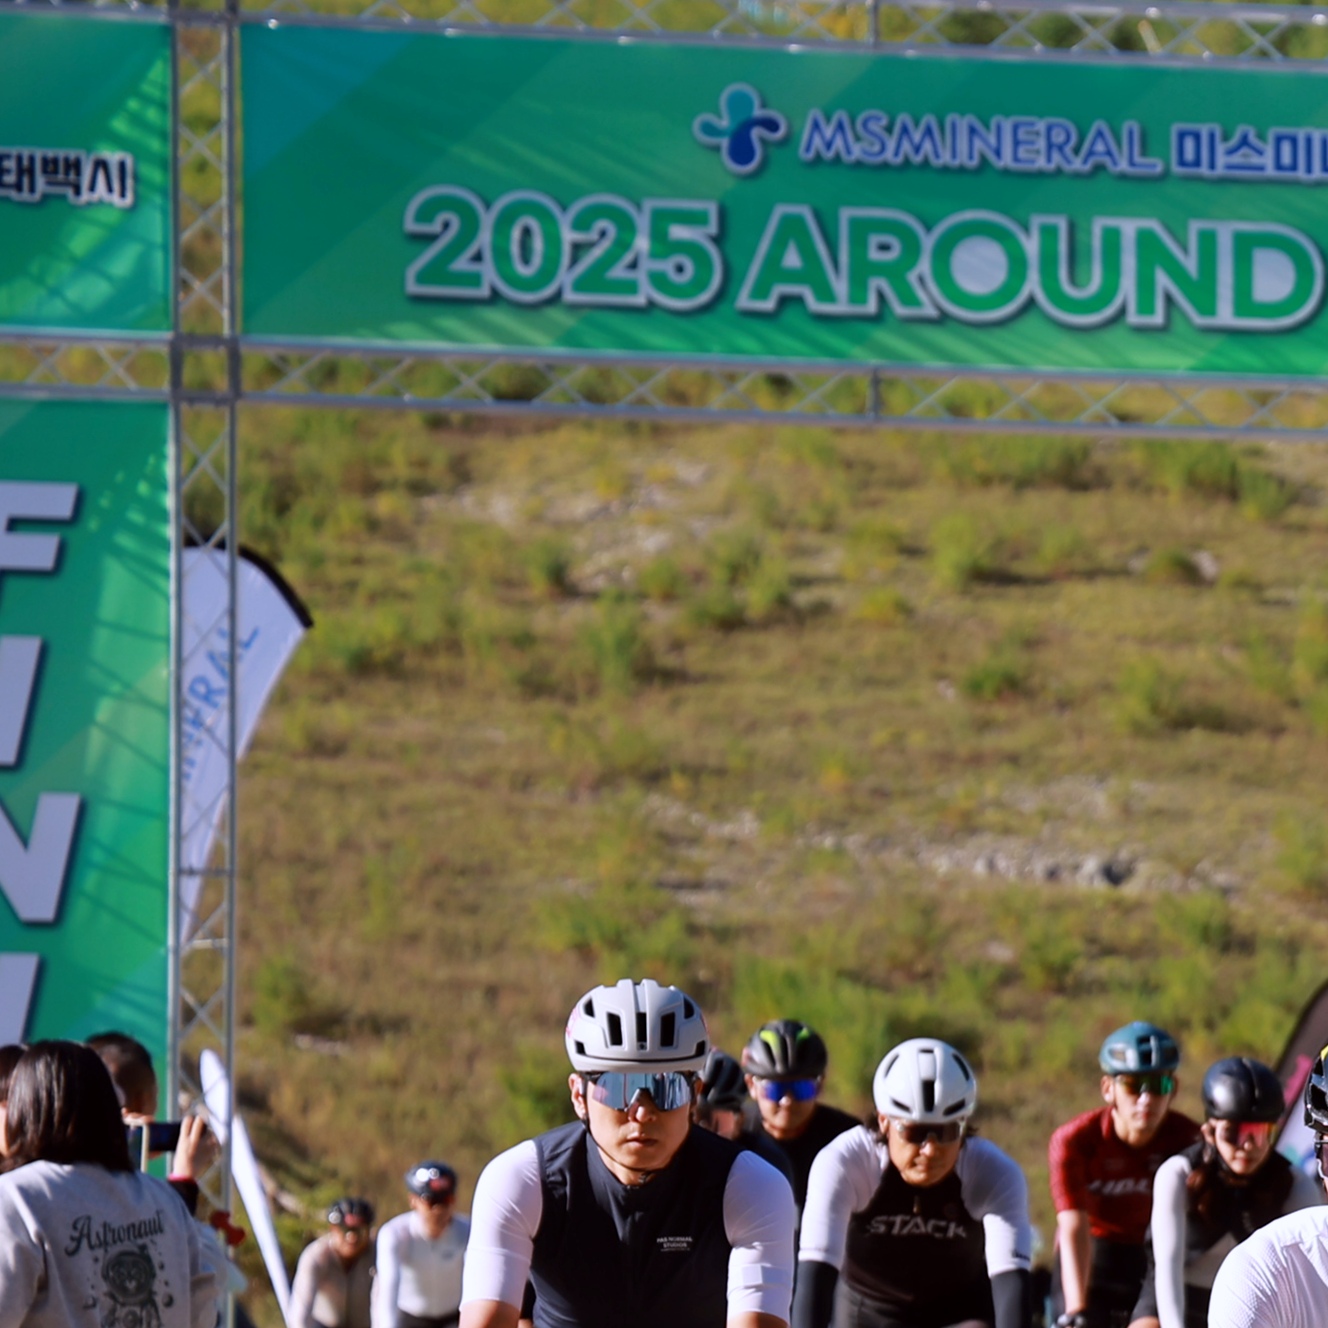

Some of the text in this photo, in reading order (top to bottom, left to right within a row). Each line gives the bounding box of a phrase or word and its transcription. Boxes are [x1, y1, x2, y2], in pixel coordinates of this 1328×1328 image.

[802, 107, 1162, 173] MSMINERAL
[404, 186, 724, 311] 2025
[737, 205, 1326, 330] AROUND
[64, 1208, 165, 1257] Astronaut
[865, 1213, 968, 1239] STACK
